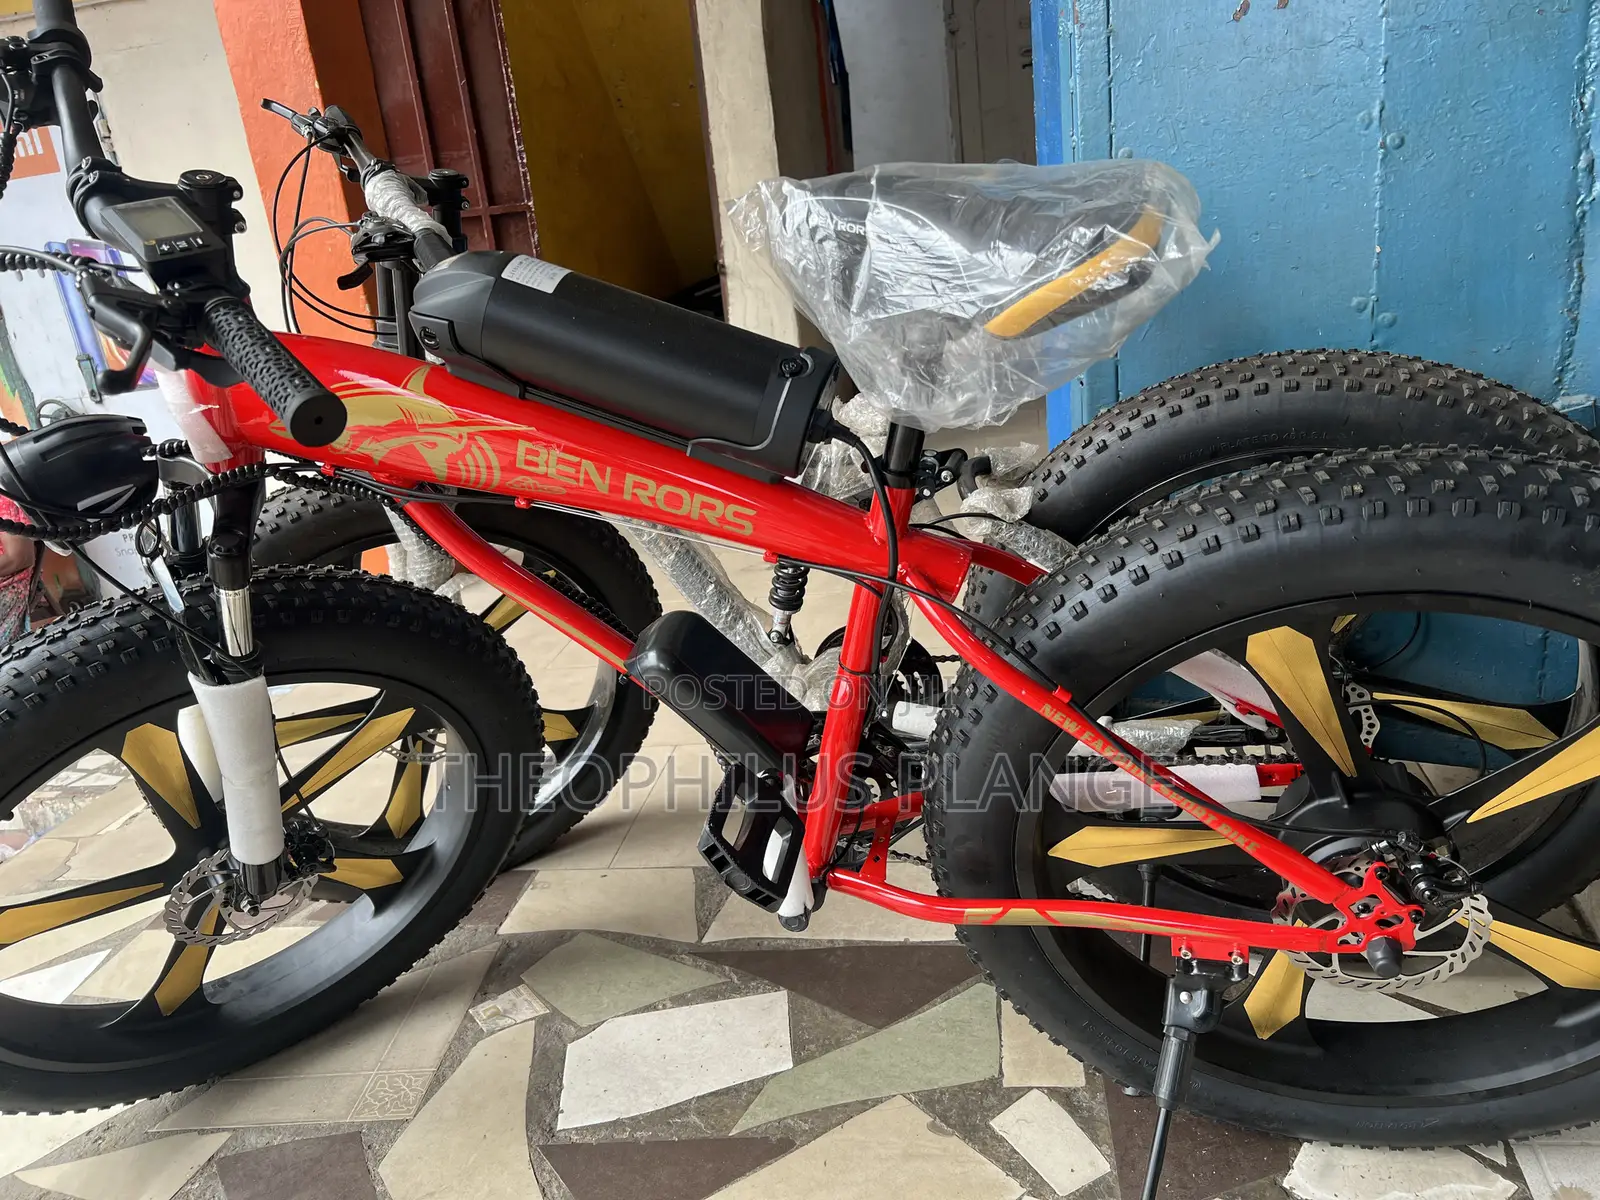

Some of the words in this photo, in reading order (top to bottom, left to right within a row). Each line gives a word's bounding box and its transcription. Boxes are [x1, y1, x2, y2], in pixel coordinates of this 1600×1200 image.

[515, 438, 612, 494] BEN
[623, 472, 757, 537] RORS
[1039, 703, 1081, 737] NEW
[1216, 821, 1263, 854] BIKE
